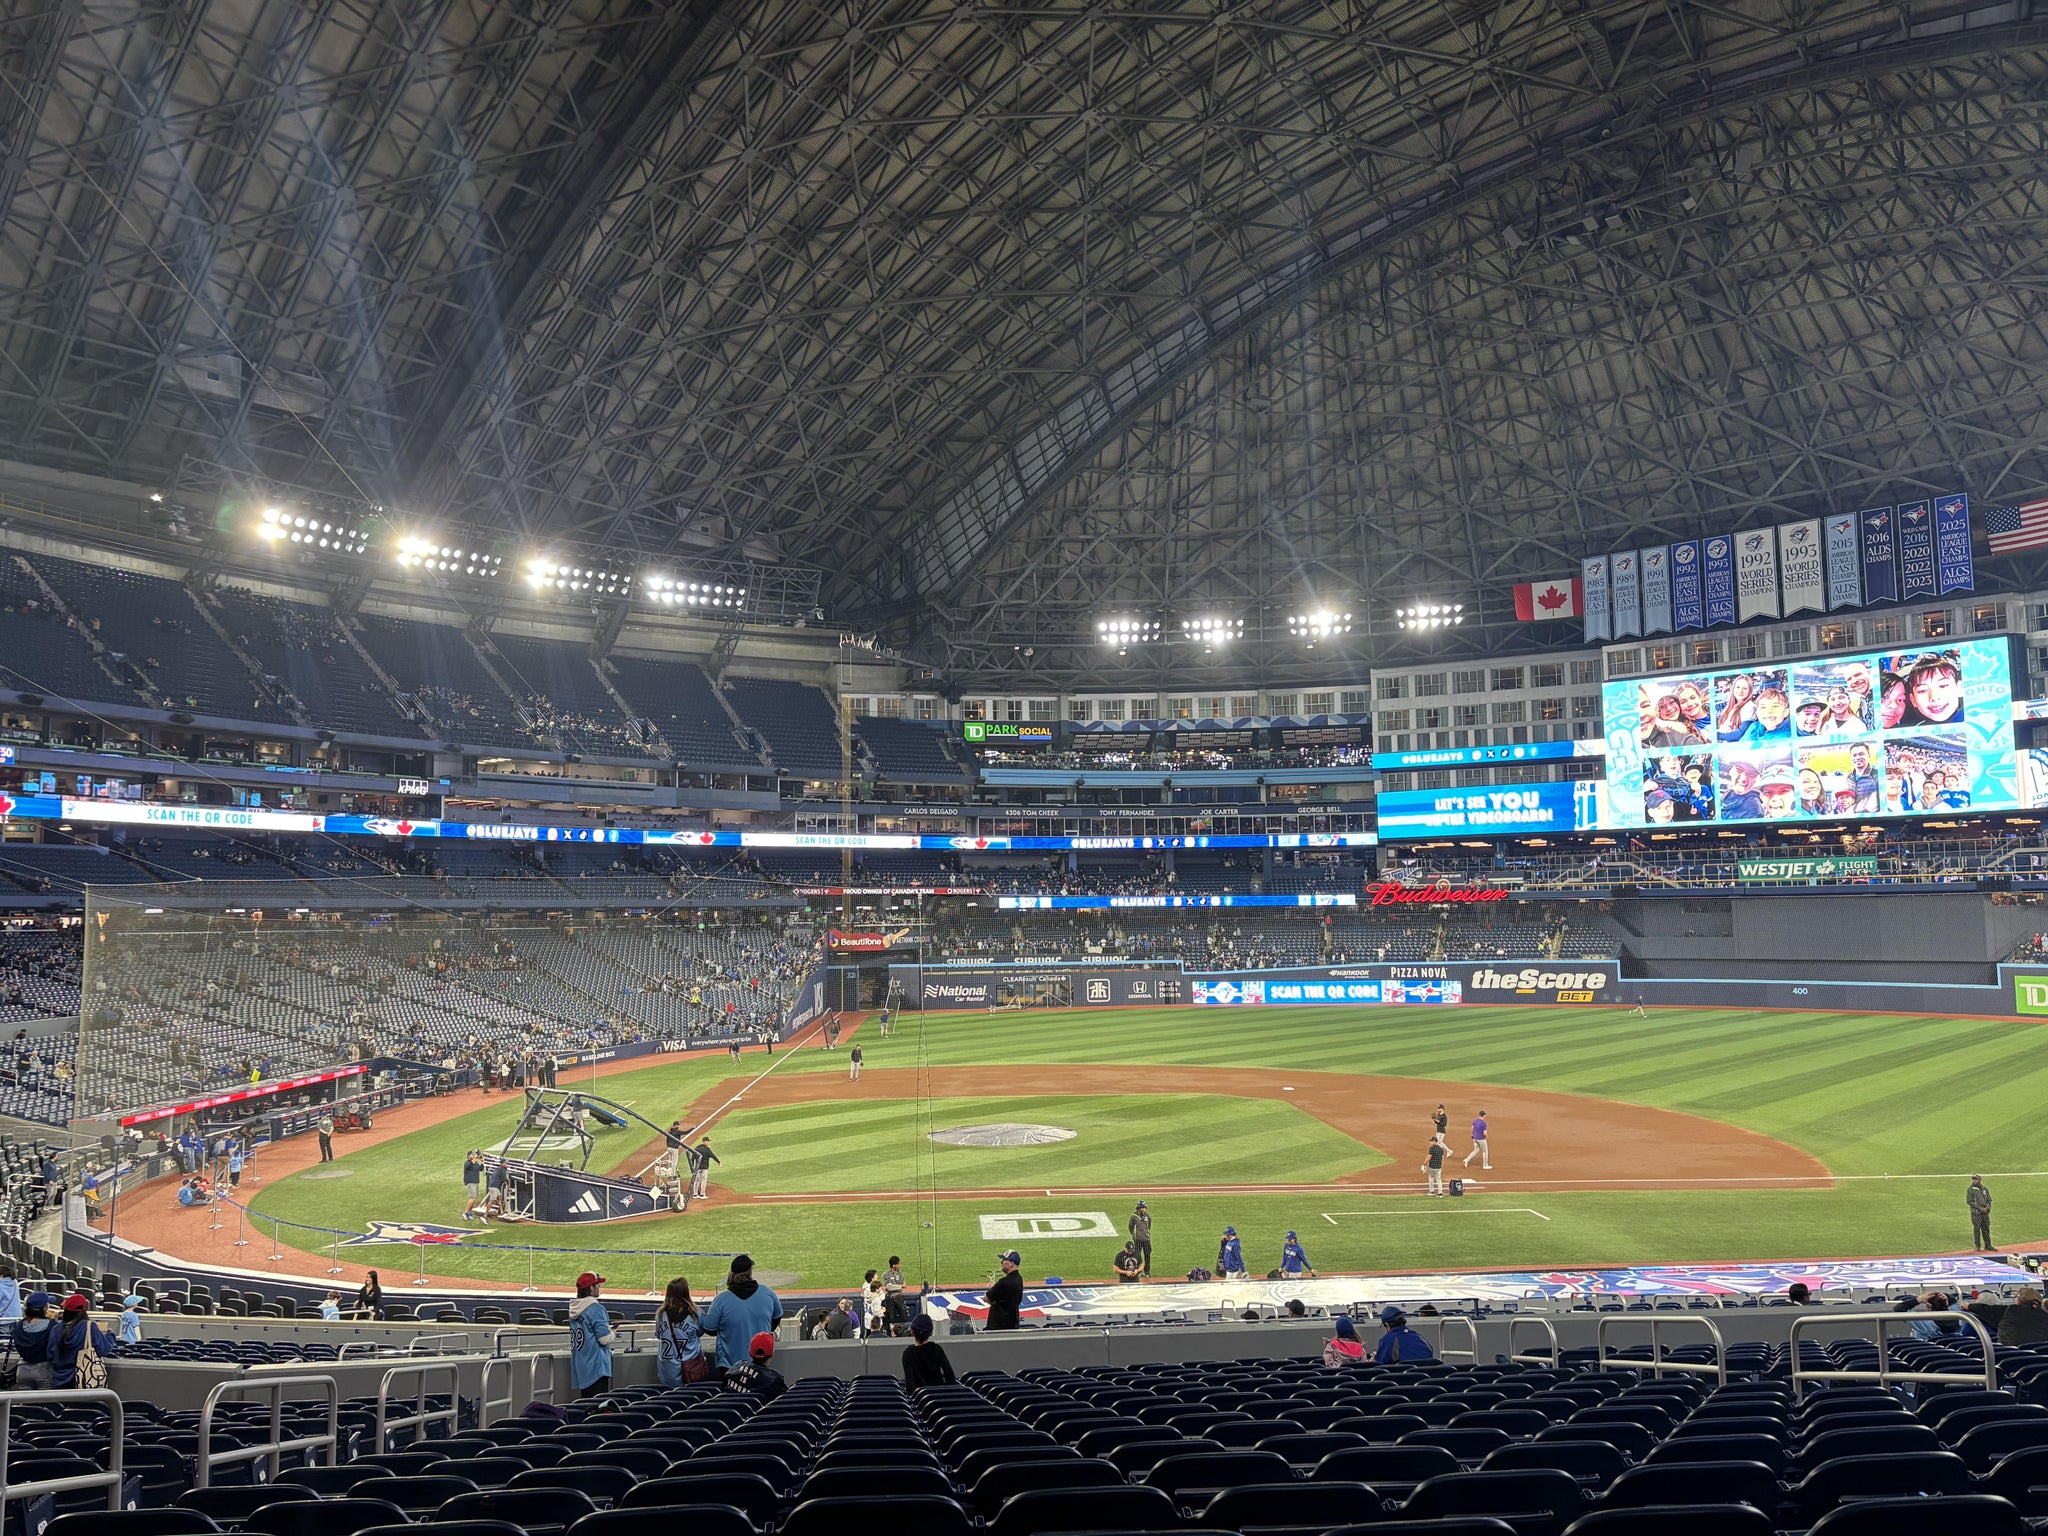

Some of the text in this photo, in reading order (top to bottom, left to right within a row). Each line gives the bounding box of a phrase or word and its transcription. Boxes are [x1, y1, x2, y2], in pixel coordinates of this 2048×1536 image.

[1940, 519, 1966, 532] 2025
[1866, 532, 1889, 544] 2016
[1904, 532, 1928, 544] 2016
[1941, 532, 1967, 540] AMERICAN
[1832, 538, 1853, 550] 2015
[1941, 538, 1967, 548] LEAGUE
[1786, 544, 1817, 561] 1993
[1866, 544, 1891, 556] ALDS
[1904, 546, 1930, 559] 2020
[1942, 545, 1968, 557] EAST
[1709, 559, 1728, 569] 1993
[1740, 552, 1771, 568] 1992
[1866, 554, 1892, 563] CHAMPS
[1942, 555, 1968, 564] CHAMPS
[1676, 564, 1696, 574] 1992
[1785, 560, 1819, 573] WORLD
[1832, 563, 1855, 574] EAST
[1905, 561, 1930, 574] 2022
[1944, 566, 1970, 578] ALCS
[1616, 575, 1634, 584] 1989
[1647, 570, 1664, 579] 1991
[1740, 568, 1773, 580] WORLD
[1785, 570, 1819, 583] SERIES
[1832, 572, 1856, 580] CHAMPS
[1676, 581, 1697, 590] LEAGUE
[1708, 576, 1730, 585] LEAGUE
[1740, 577, 1774, 590] SERIES
[1785, 580, 1820, 590] CHAMPIONS
[1906, 575, 1932, 588] 2023
[1943, 576, 1970, 586] CHAMPS
[1677, 588, 1696, 597] EAST
[1709, 583, 1729, 592] EAST
[1740, 587, 1774, 597] CHAMPIONS
[1834, 583, 1856, 594] ALDS
[1647, 592, 1667, 601] EAST
[1677, 596, 1698, 604] CHAMPS
[1709, 591, 1731, 599] CHAMPS
[1833, 592, 1857, 601] CHAMPS
[1587, 601, 1605, 610] EAST
[1616, 597, 1635, 606] EAST
[1710, 601, 1732, 611] ALCS
[1678, 605, 1699, 616] ALCS
[1710, 610, 1732, 619] CHAMPS
[1678, 615, 1700, 623] CHAMPS
[966, 726, 983, 737] TD
[986, 725, 1018, 734] PARK
[1402, 752, 1464, 764] @BLUEJAYS
[398, 785, 427, 795] KPMG
[1435, 791, 1540, 811] LET'S SEE YOU
[147, 809, 252, 824] SCAN THE QR CODE
[1468, 808, 1553, 825] VIDEOBOARD!
[466, 825, 538, 839] @BLUEJAYS
[1071, 838, 1134, 848] @BLUEJAYS
[1740, 862, 1814, 879] WESTJET
[1839, 861, 1874, 869] FLIGHT
[1366, 882, 1508, 906] Budweiser
[841, 938, 881, 946] BeautiTone
[1391, 967, 1447, 978] PIZZA NOVA
[1472, 969, 1606, 990] theScore
[1271, 985, 1379, 999] SCAN THE QR CODE
[1560, 992, 1590, 1000] BET
[2019, 984, 2048, 1006] TD
[757, 1033, 780, 1043] VIA
[662, 1040, 686, 1051] VISA
[662, 1339, 688, 1360] 27
[740, 1366, 758, 1379] HOME
